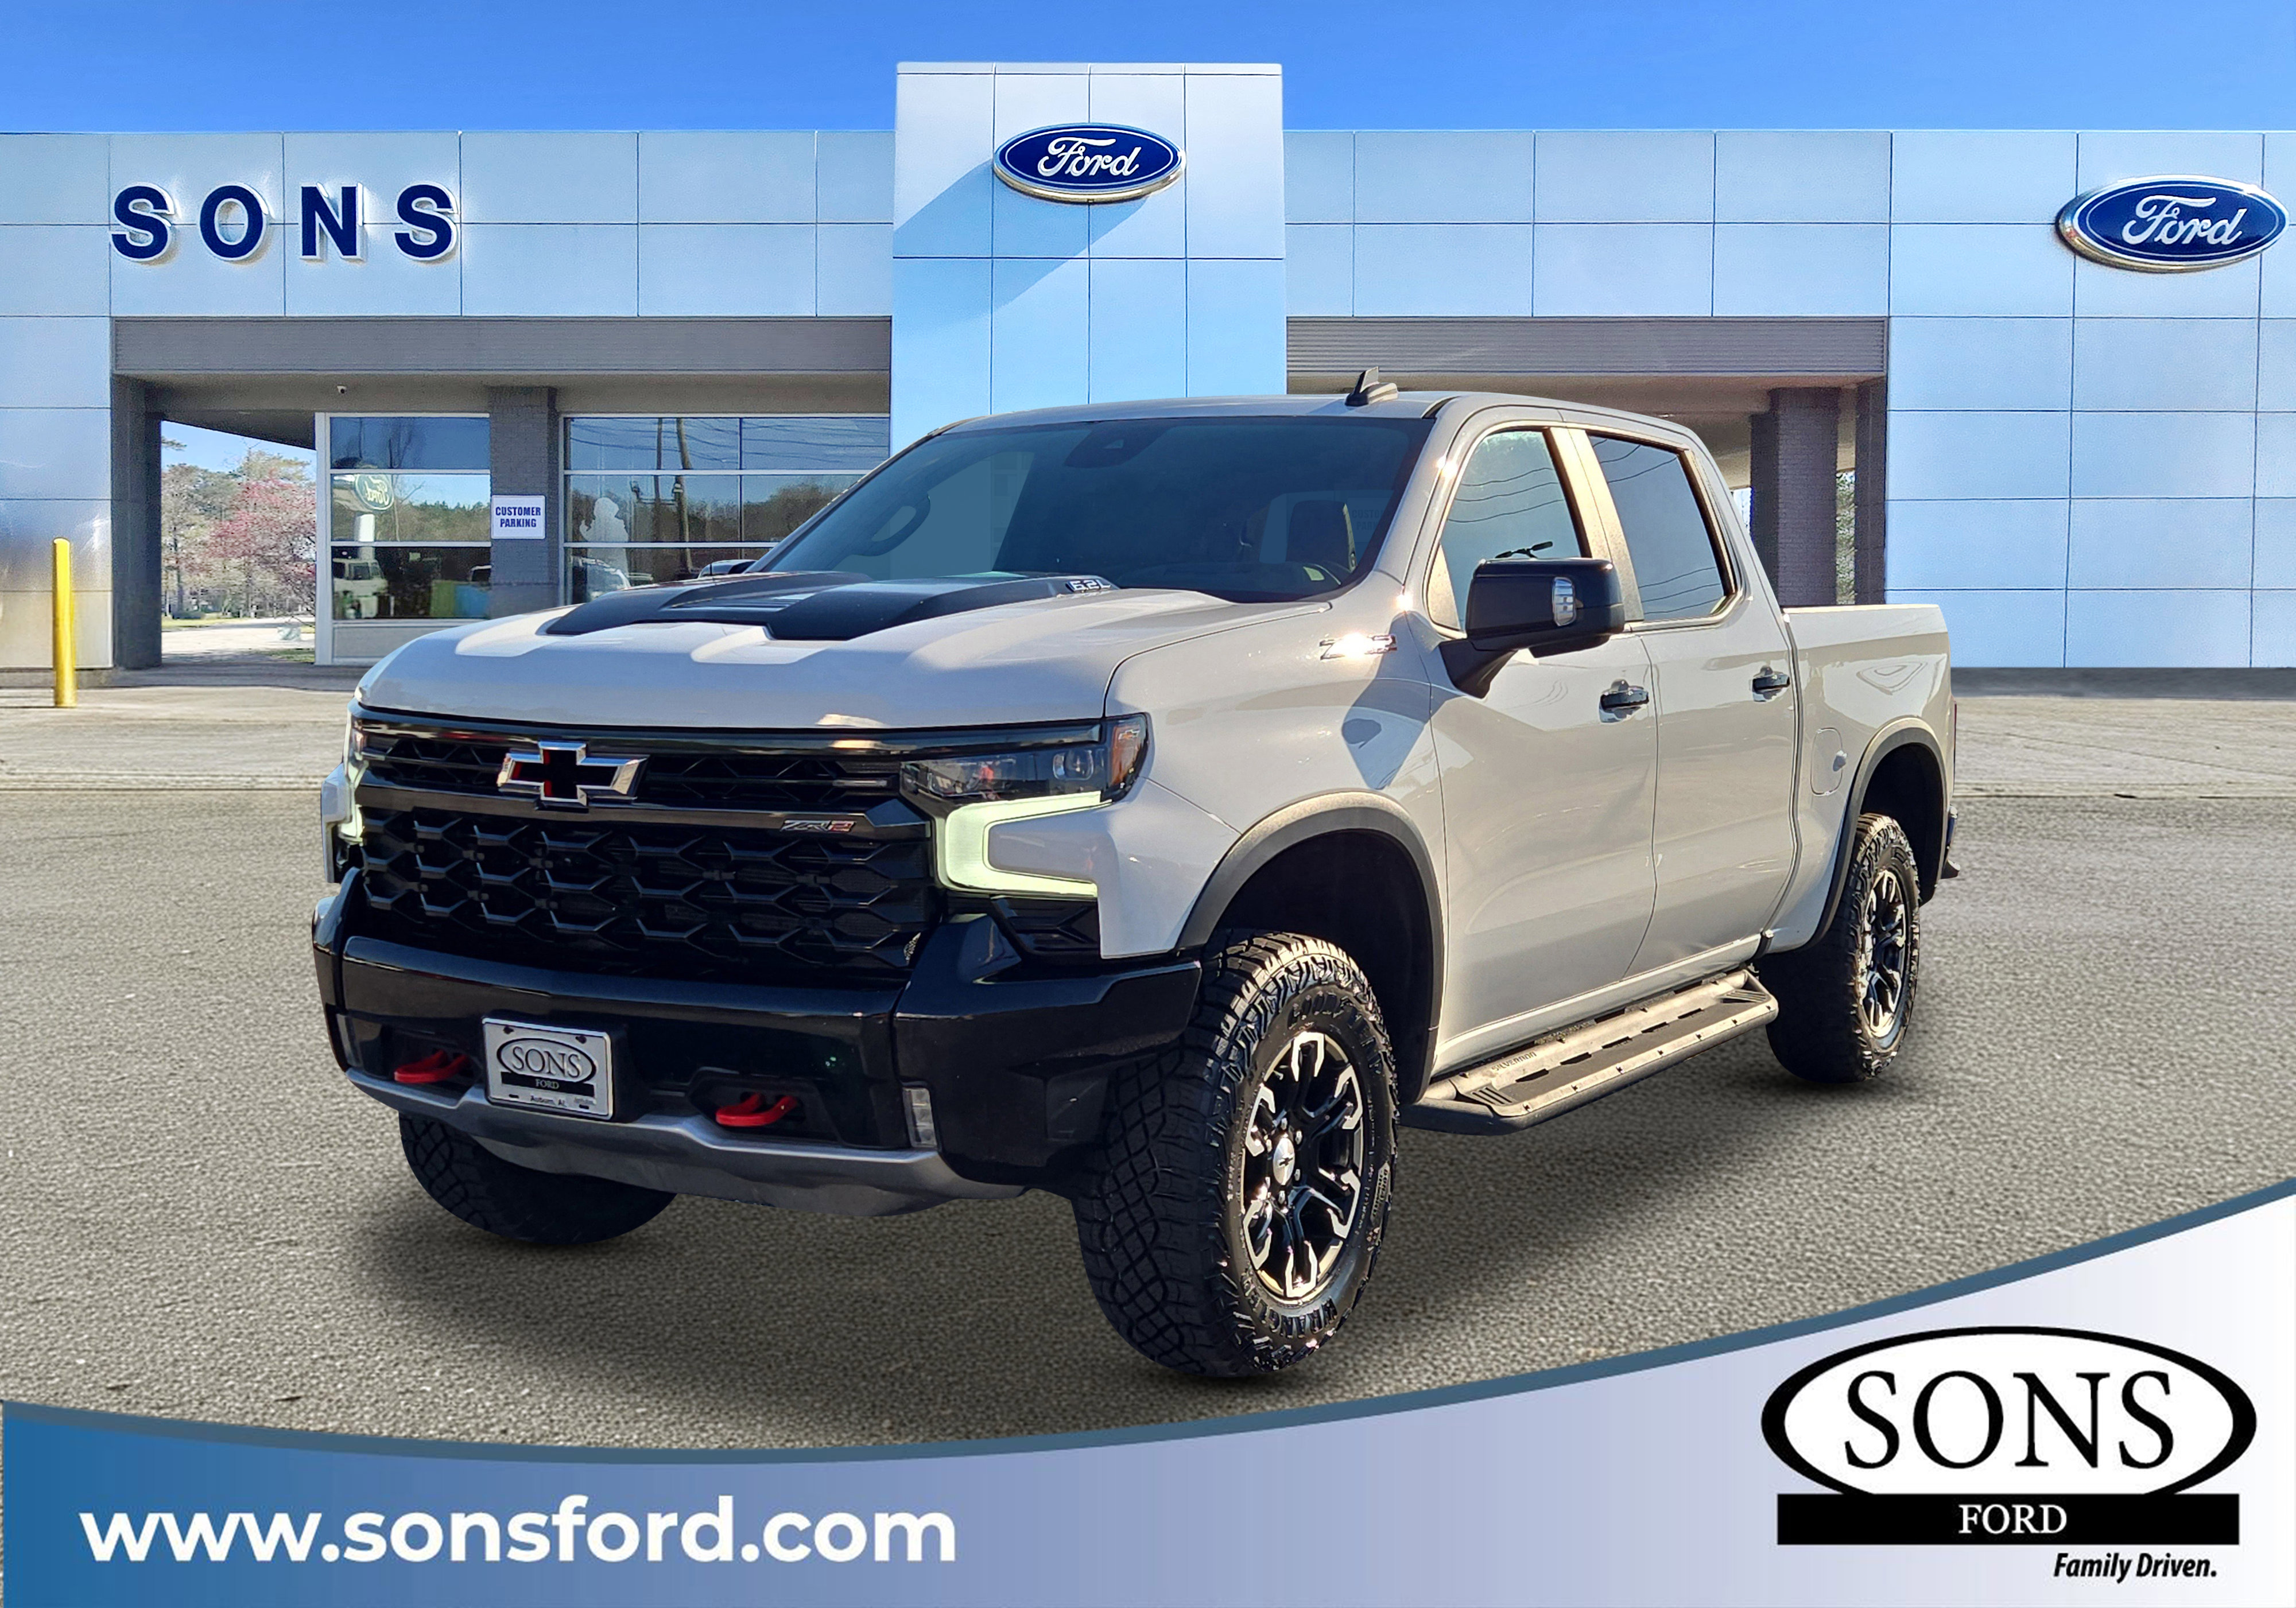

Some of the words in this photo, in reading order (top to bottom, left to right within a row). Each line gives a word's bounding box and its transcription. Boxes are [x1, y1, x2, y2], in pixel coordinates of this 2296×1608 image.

[1037, 137, 1142, 177] Ford
[111, 183, 458, 261] SONS
[2122, 195, 2247, 245] Ford
[495, 507, 541, 516] CUSTOMER
[500, 519, 537, 527] PARKING
[779, 819, 856, 832] ZR2
[511, 1046, 581, 1079] SONS
[535, 1078, 560, 1089] FORD
